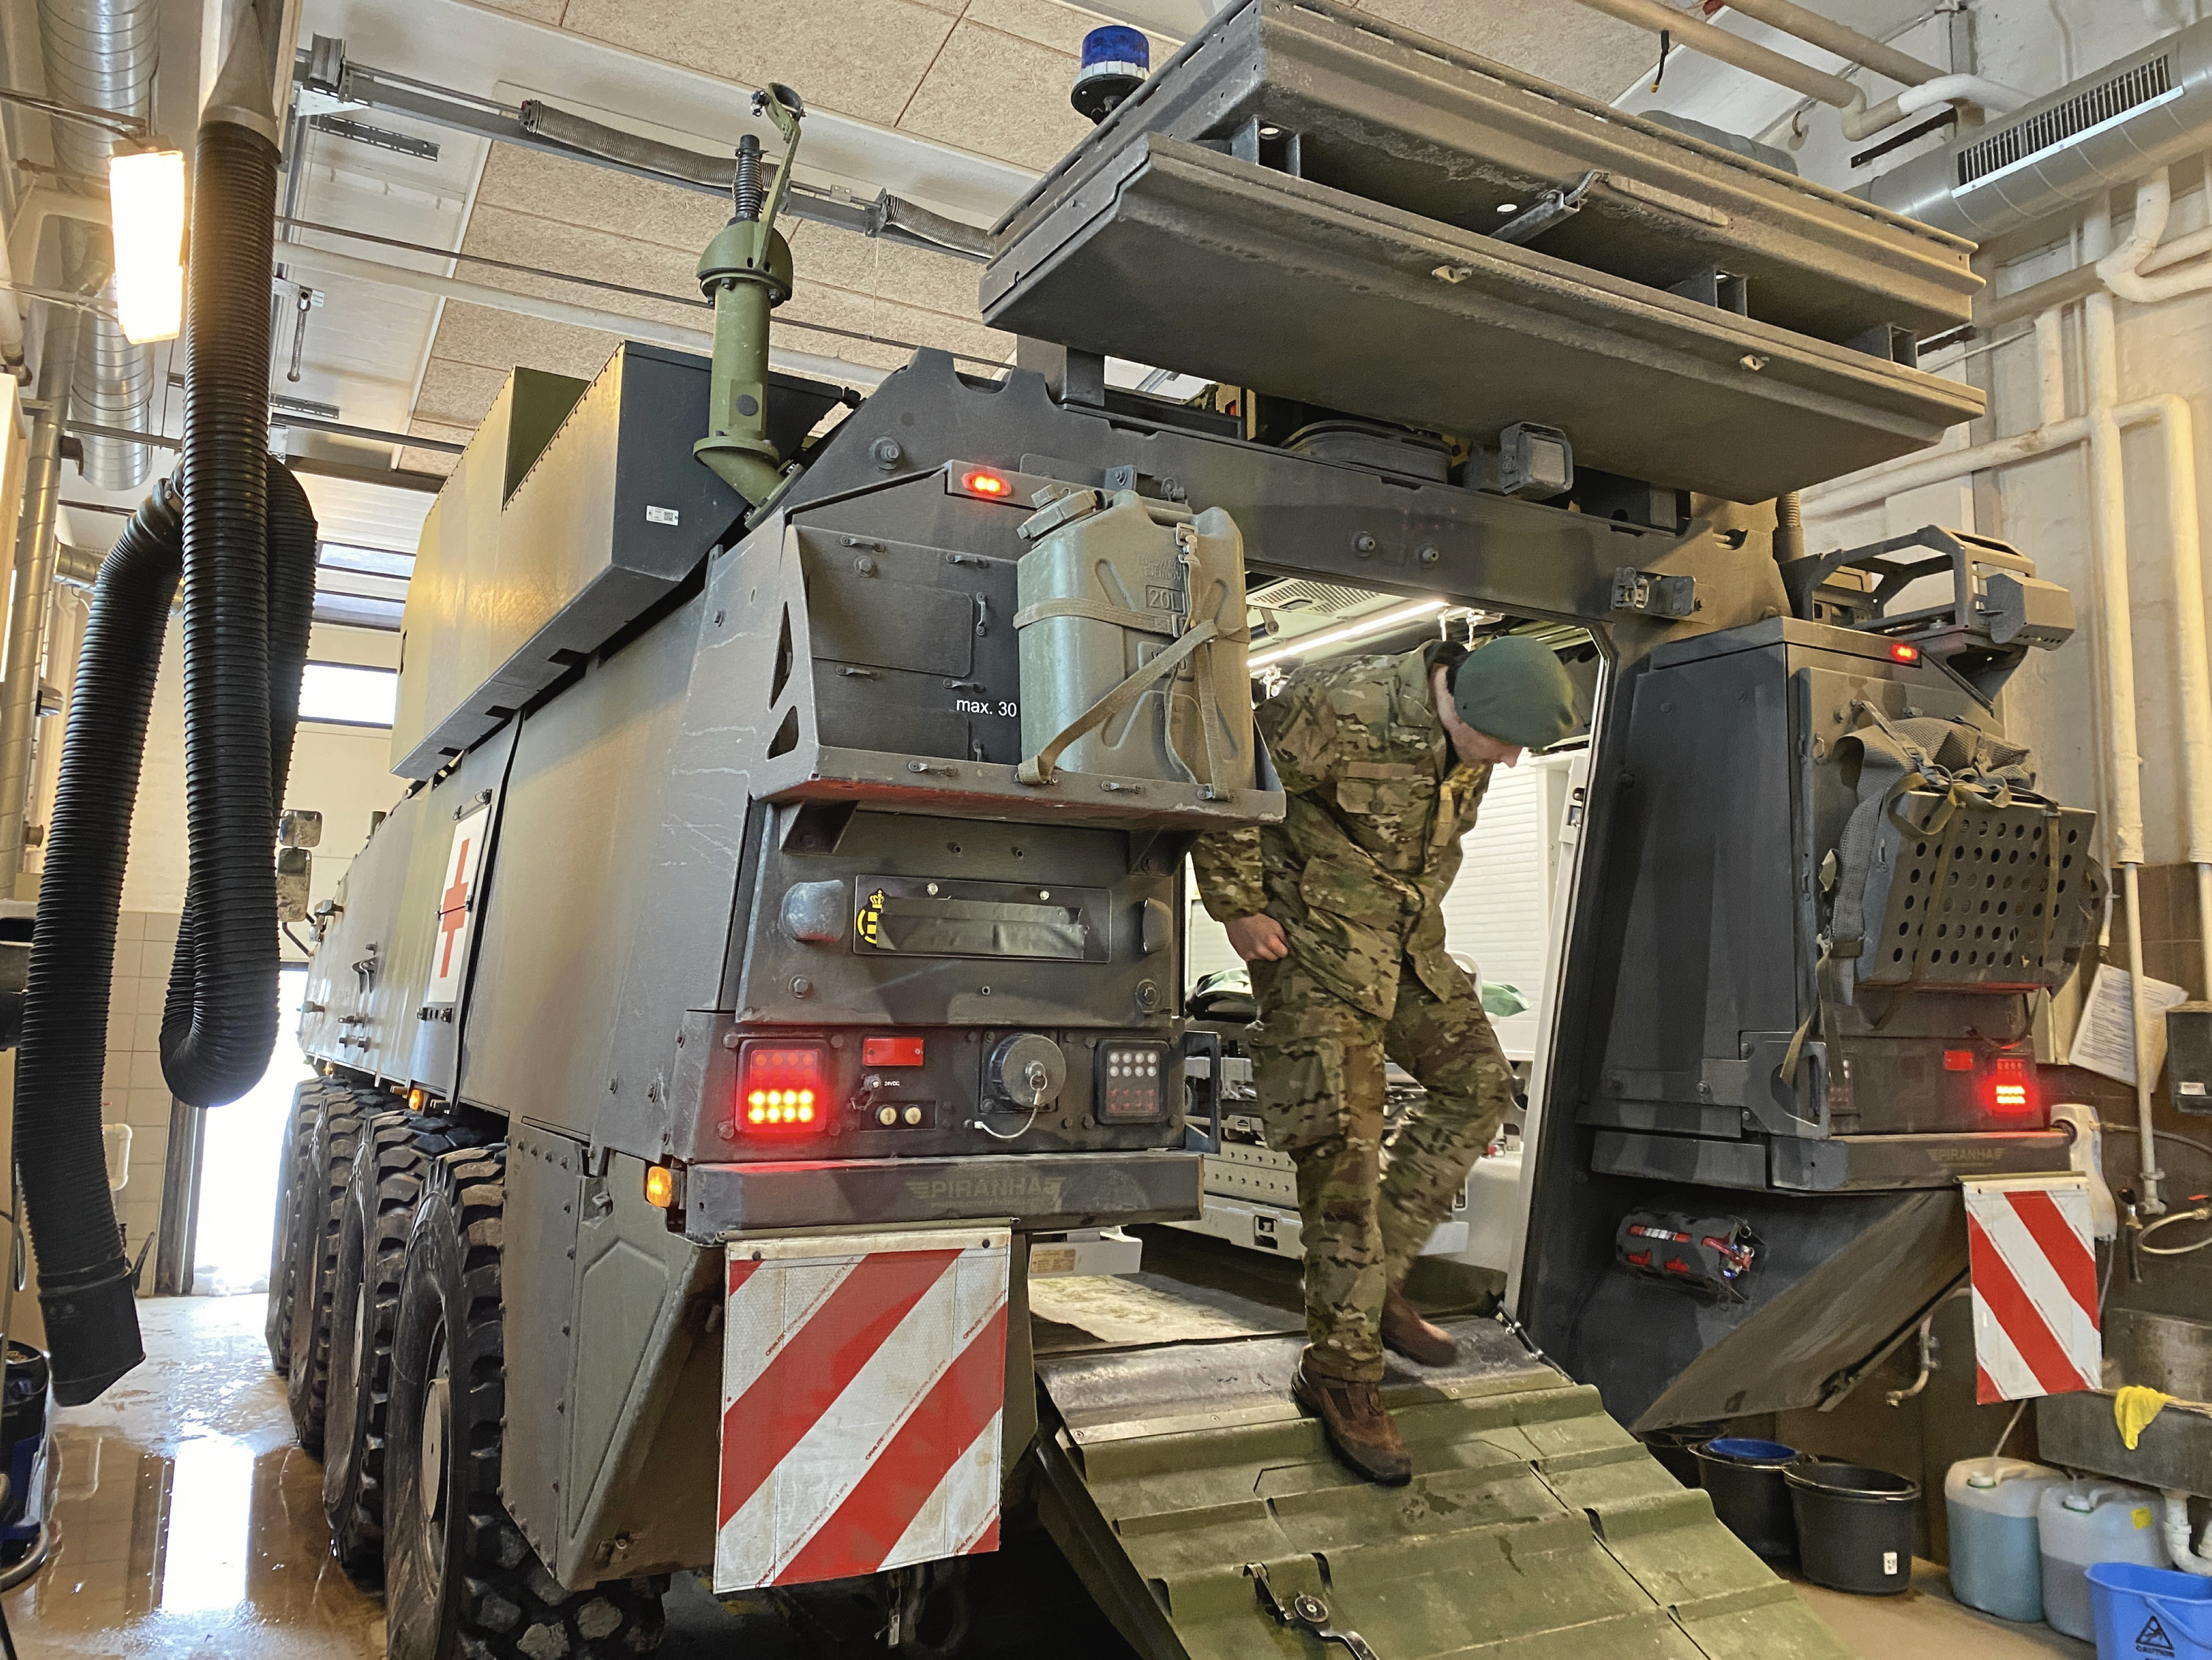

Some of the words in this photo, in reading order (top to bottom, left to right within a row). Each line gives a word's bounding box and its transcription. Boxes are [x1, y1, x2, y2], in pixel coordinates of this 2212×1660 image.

[956, 699, 992, 715] max.
[998, 701, 1017, 717] 30
[1938, 1148, 1994, 1161] PIRANHA
[931, 1177, 1043, 1199] PIRANHA
